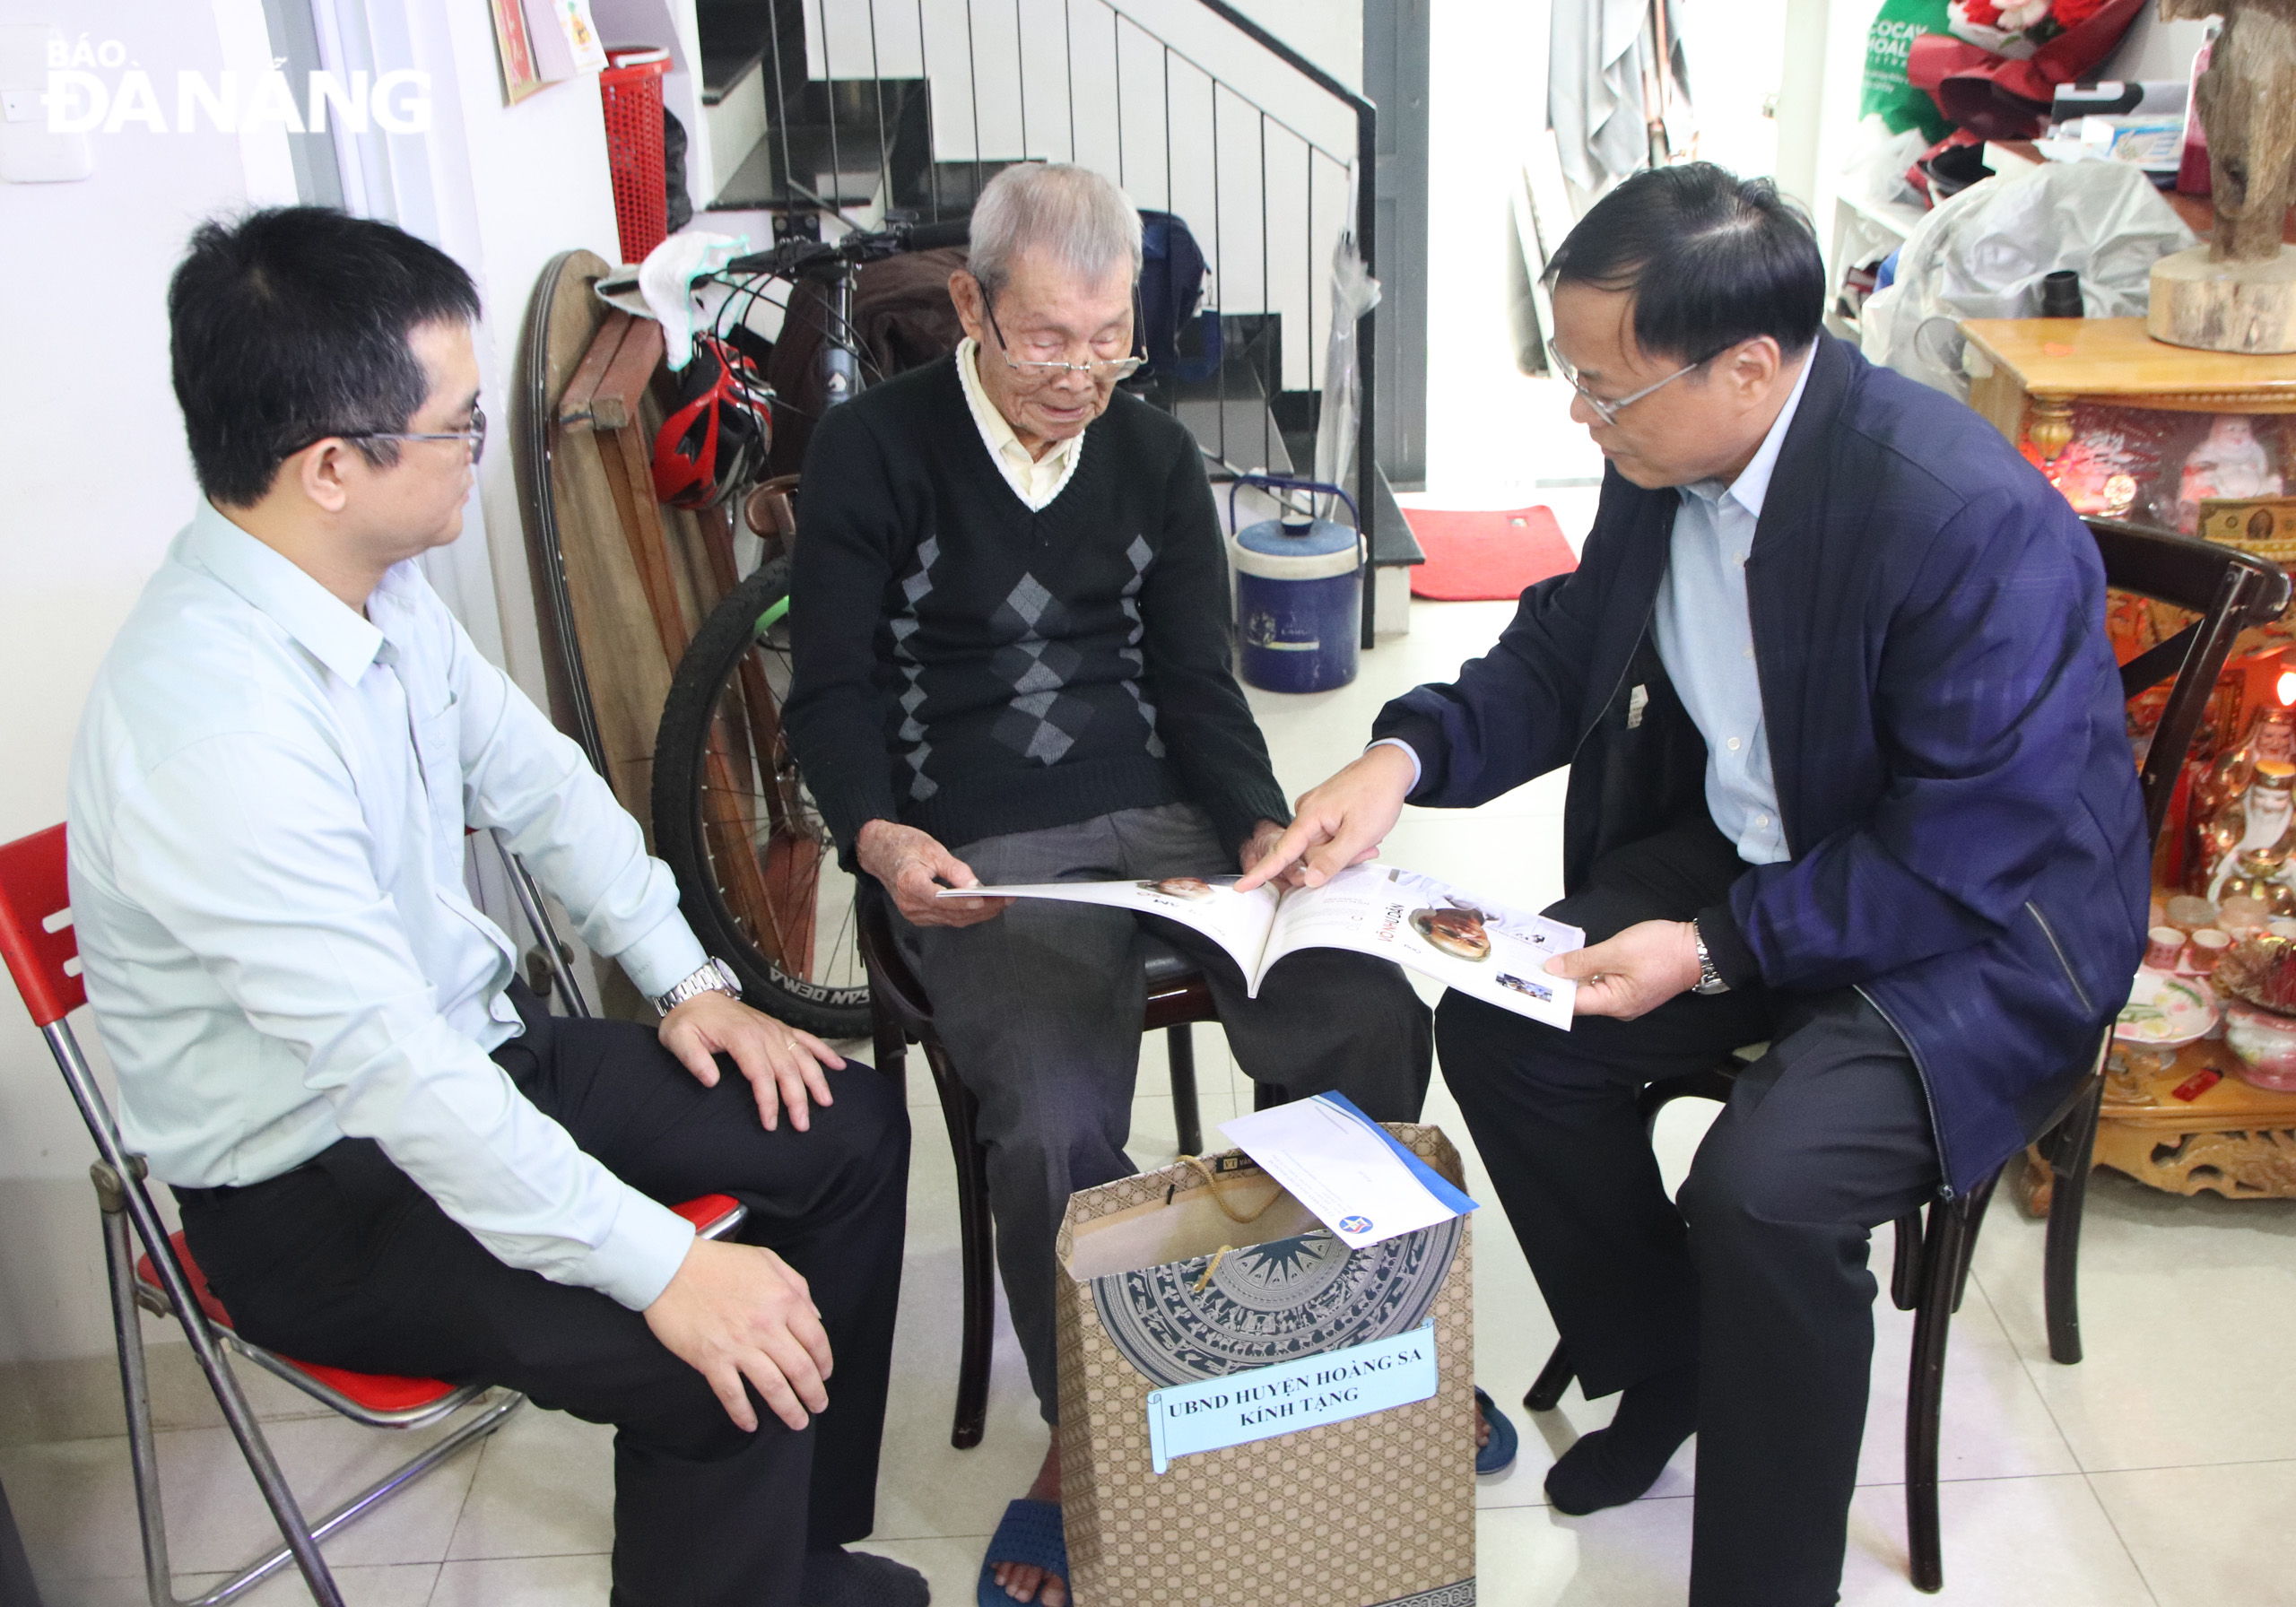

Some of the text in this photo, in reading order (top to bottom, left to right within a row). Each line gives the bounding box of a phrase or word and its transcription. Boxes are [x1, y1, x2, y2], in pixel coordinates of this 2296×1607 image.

[1169, 1348, 1422, 1418] UBND HUYỆN HOÀNG SA
[1239, 1401, 1294, 1427] KÍNH
